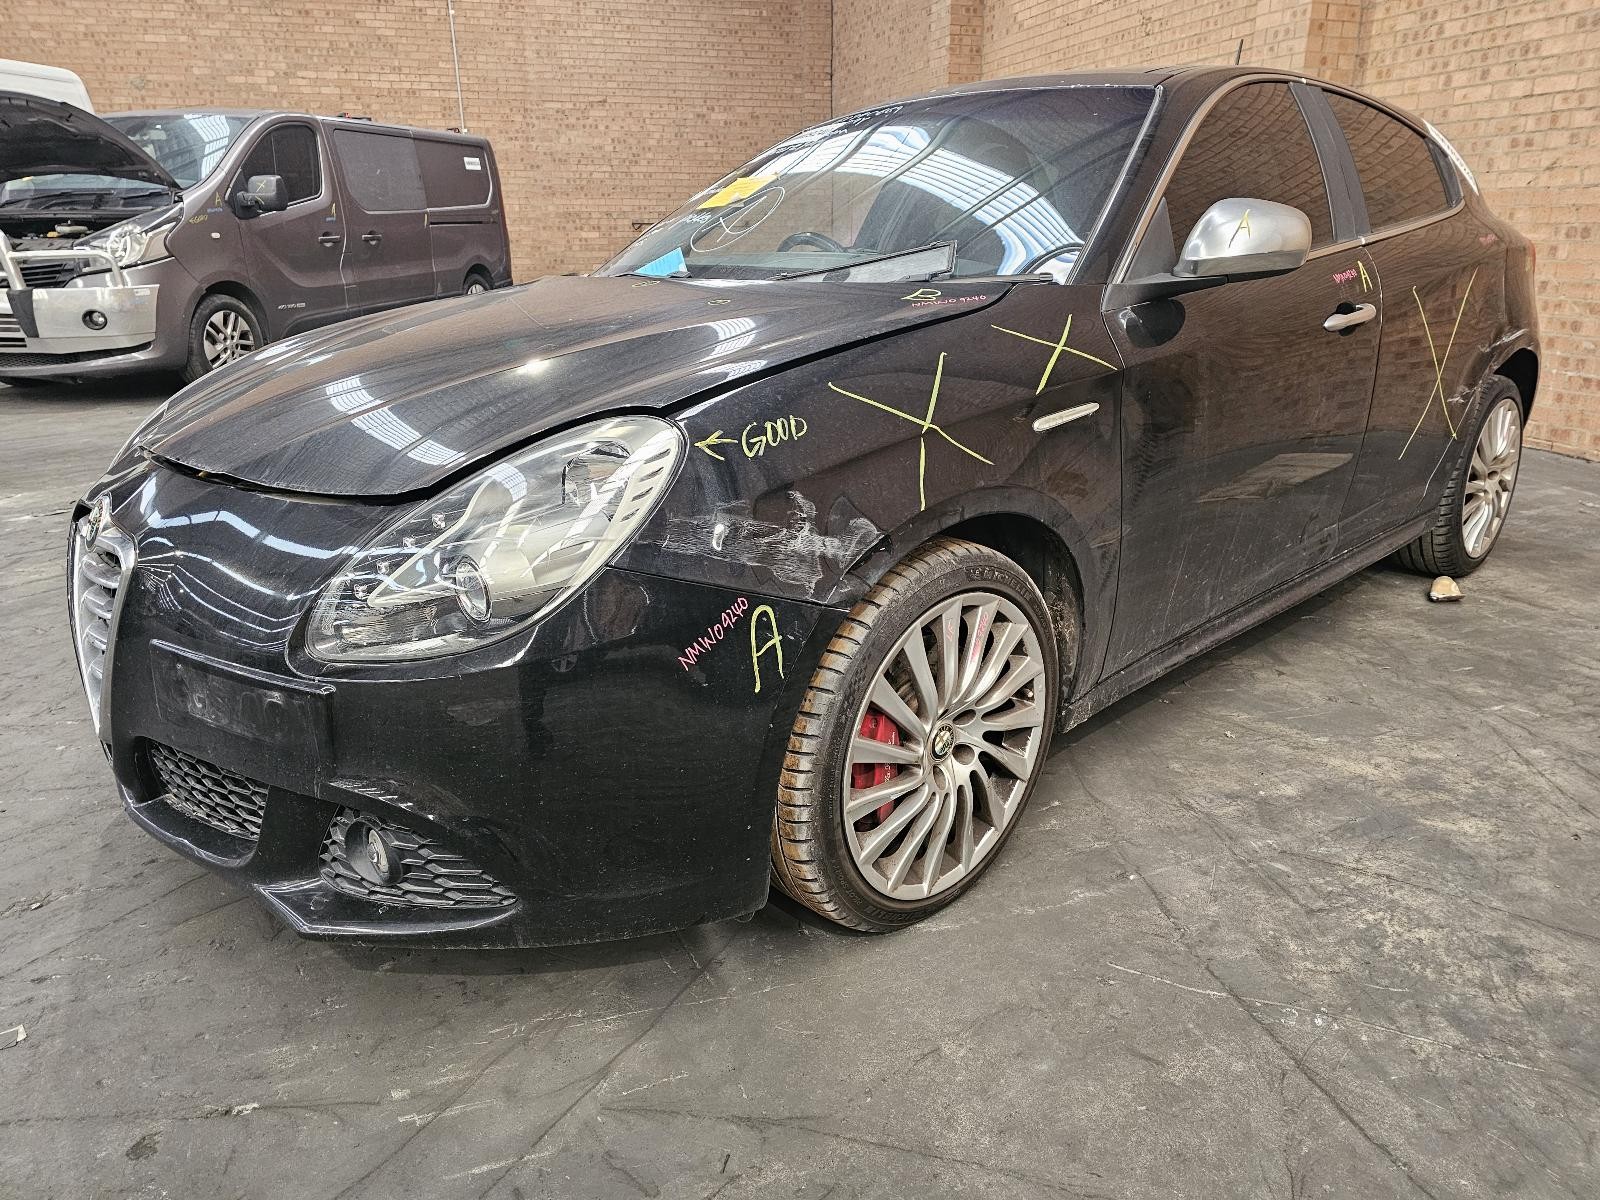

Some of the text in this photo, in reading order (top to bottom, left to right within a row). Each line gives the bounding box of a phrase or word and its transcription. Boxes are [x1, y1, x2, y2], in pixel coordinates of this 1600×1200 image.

[1228, 208, 1251, 248] A
[1357, 260, 1374, 293] A
[741, 414, 808, 461] GOOD
[677, 597, 749, 672] NMW09240
[750, 604, 785, 693] A
